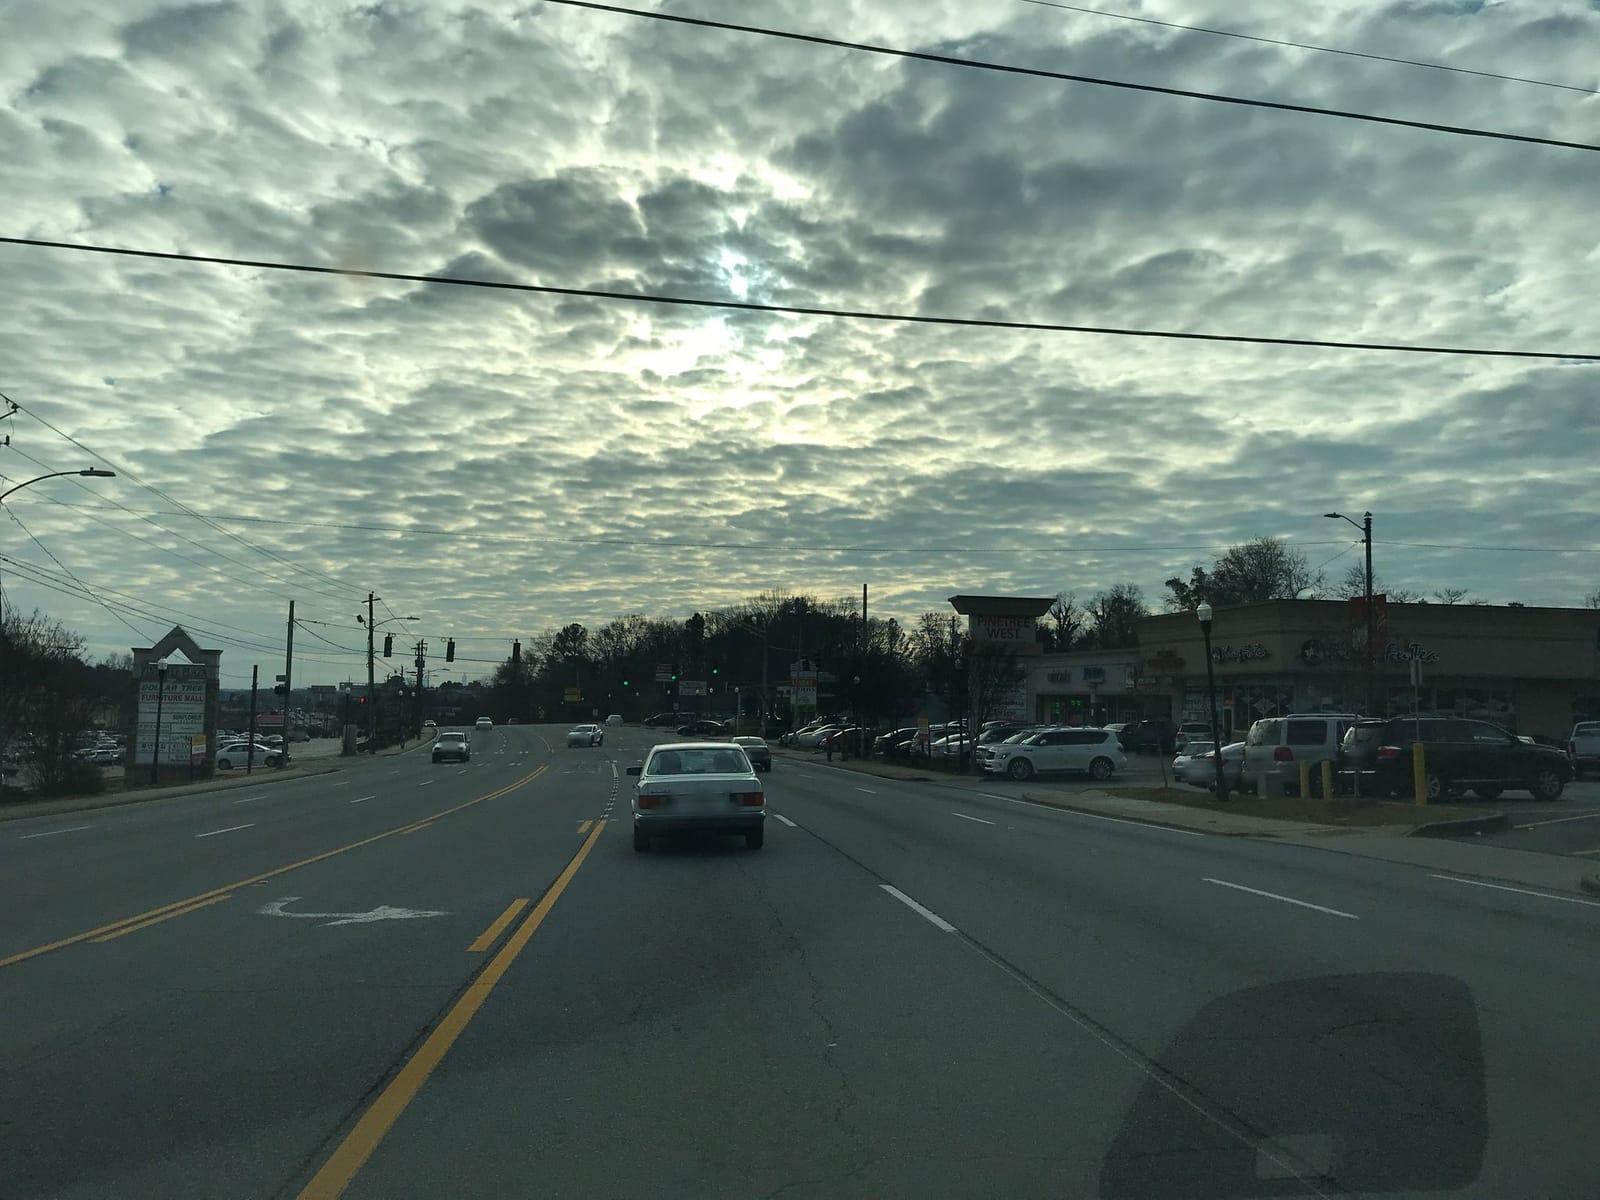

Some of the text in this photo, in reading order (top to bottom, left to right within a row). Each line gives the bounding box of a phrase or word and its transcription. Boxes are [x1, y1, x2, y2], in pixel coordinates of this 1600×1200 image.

[987, 628, 1021, 639] WEST
[142, 684, 203, 693] DOLAR TREE
[142, 694, 204, 702] FURNTURE MALL
